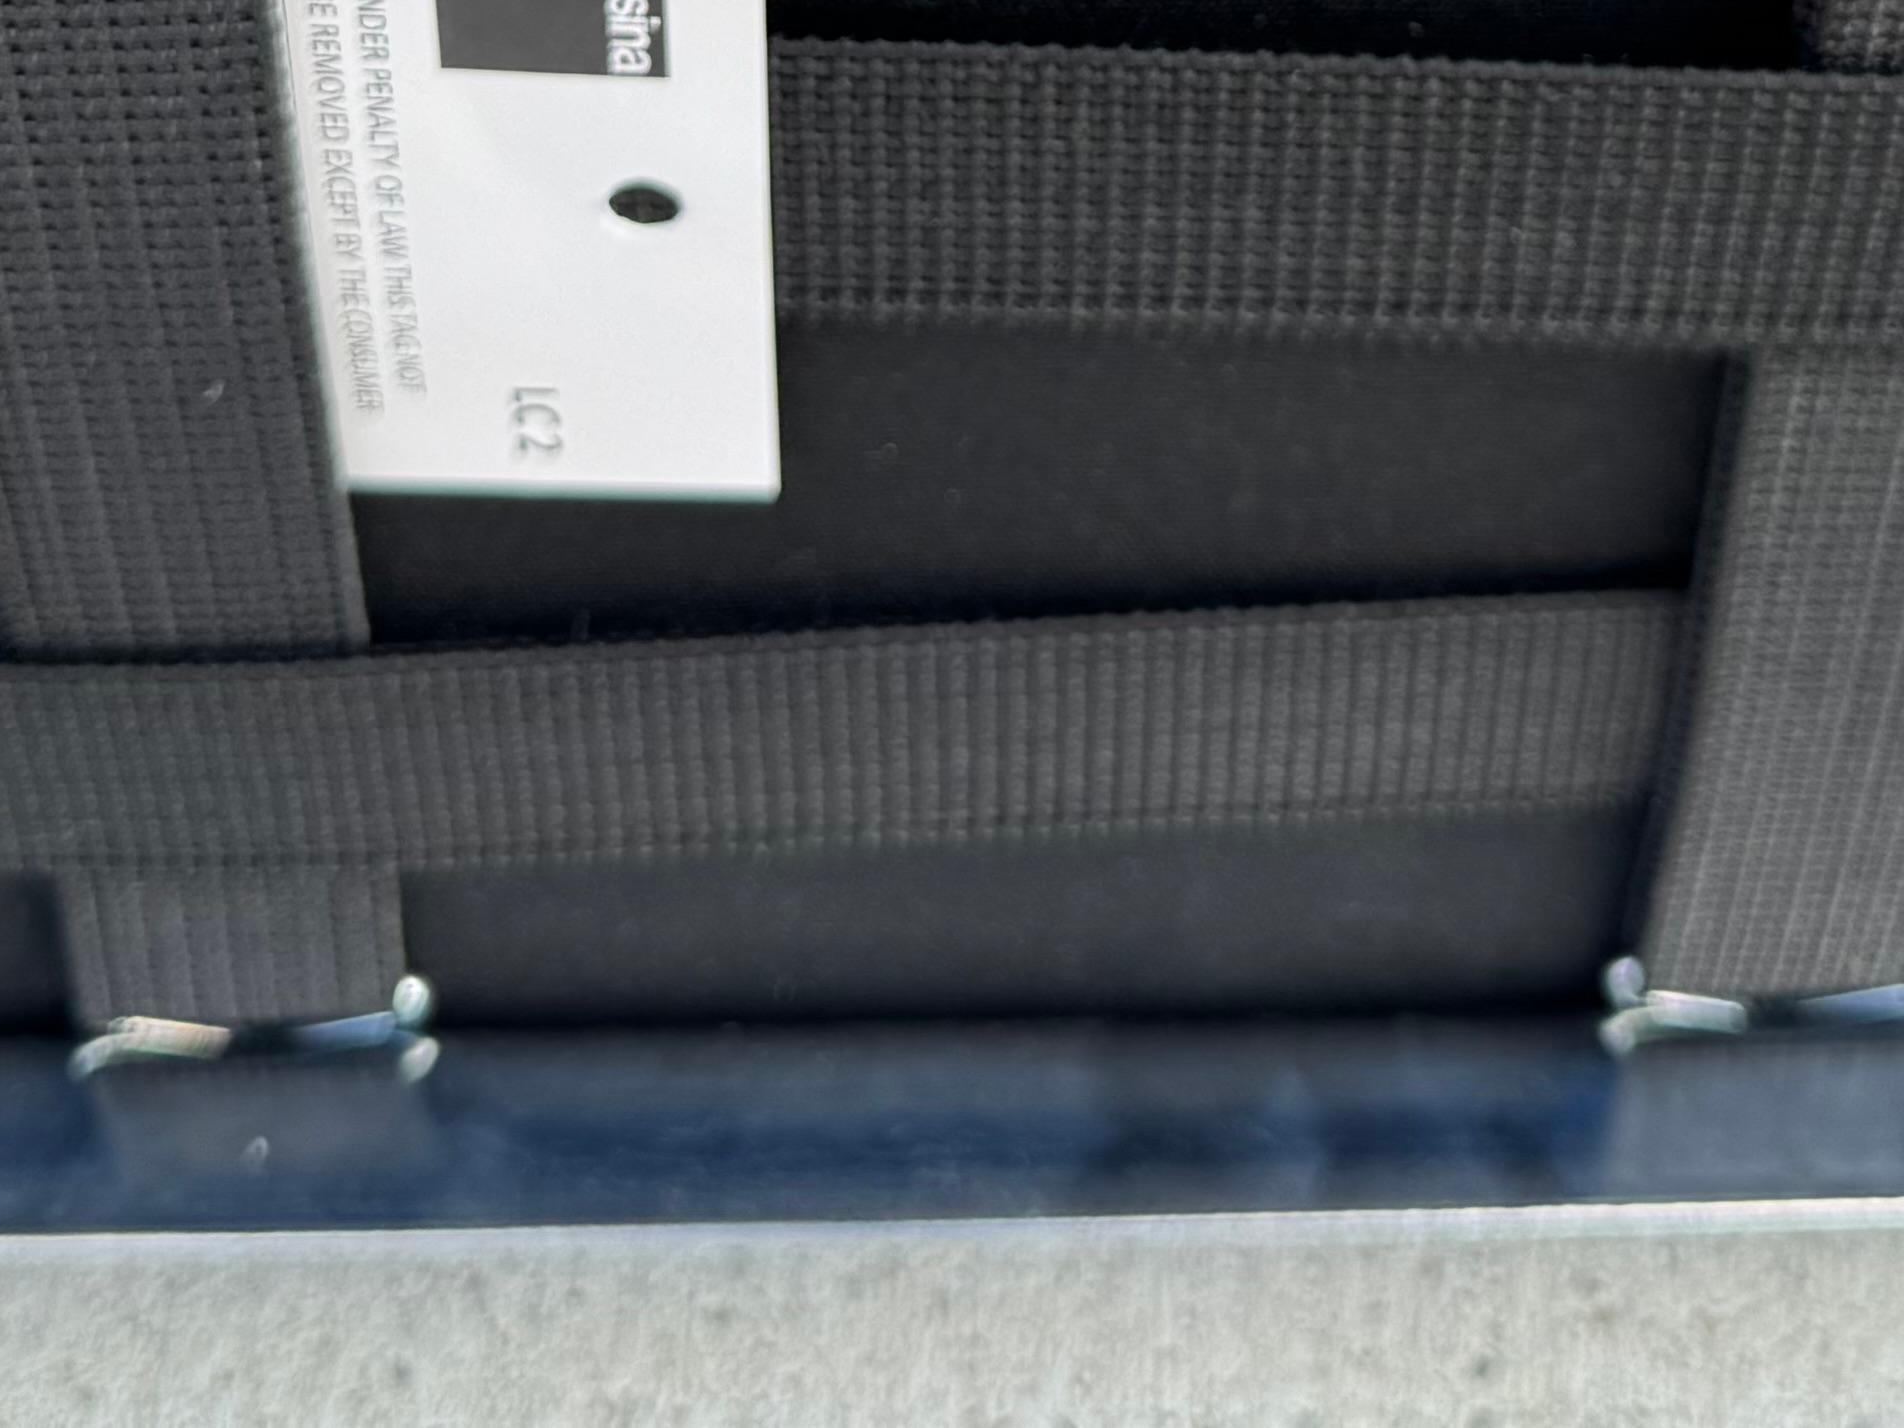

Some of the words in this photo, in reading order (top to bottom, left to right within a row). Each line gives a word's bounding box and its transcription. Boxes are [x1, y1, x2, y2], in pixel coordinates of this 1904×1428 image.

[311, 24, 349, 142] REMOVED
[364, 67, 400, 168] PENALTY
[324, 149, 362, 226] EXCEPT
[374, 176, 403, 205] OF
[335, 233, 364, 262] BY
[378, 210, 410, 258] LAW
[342, 268, 371, 308] THE
[387, 264, 417, 307] THIS
[345, 308, 384, 412] CONSUMER
